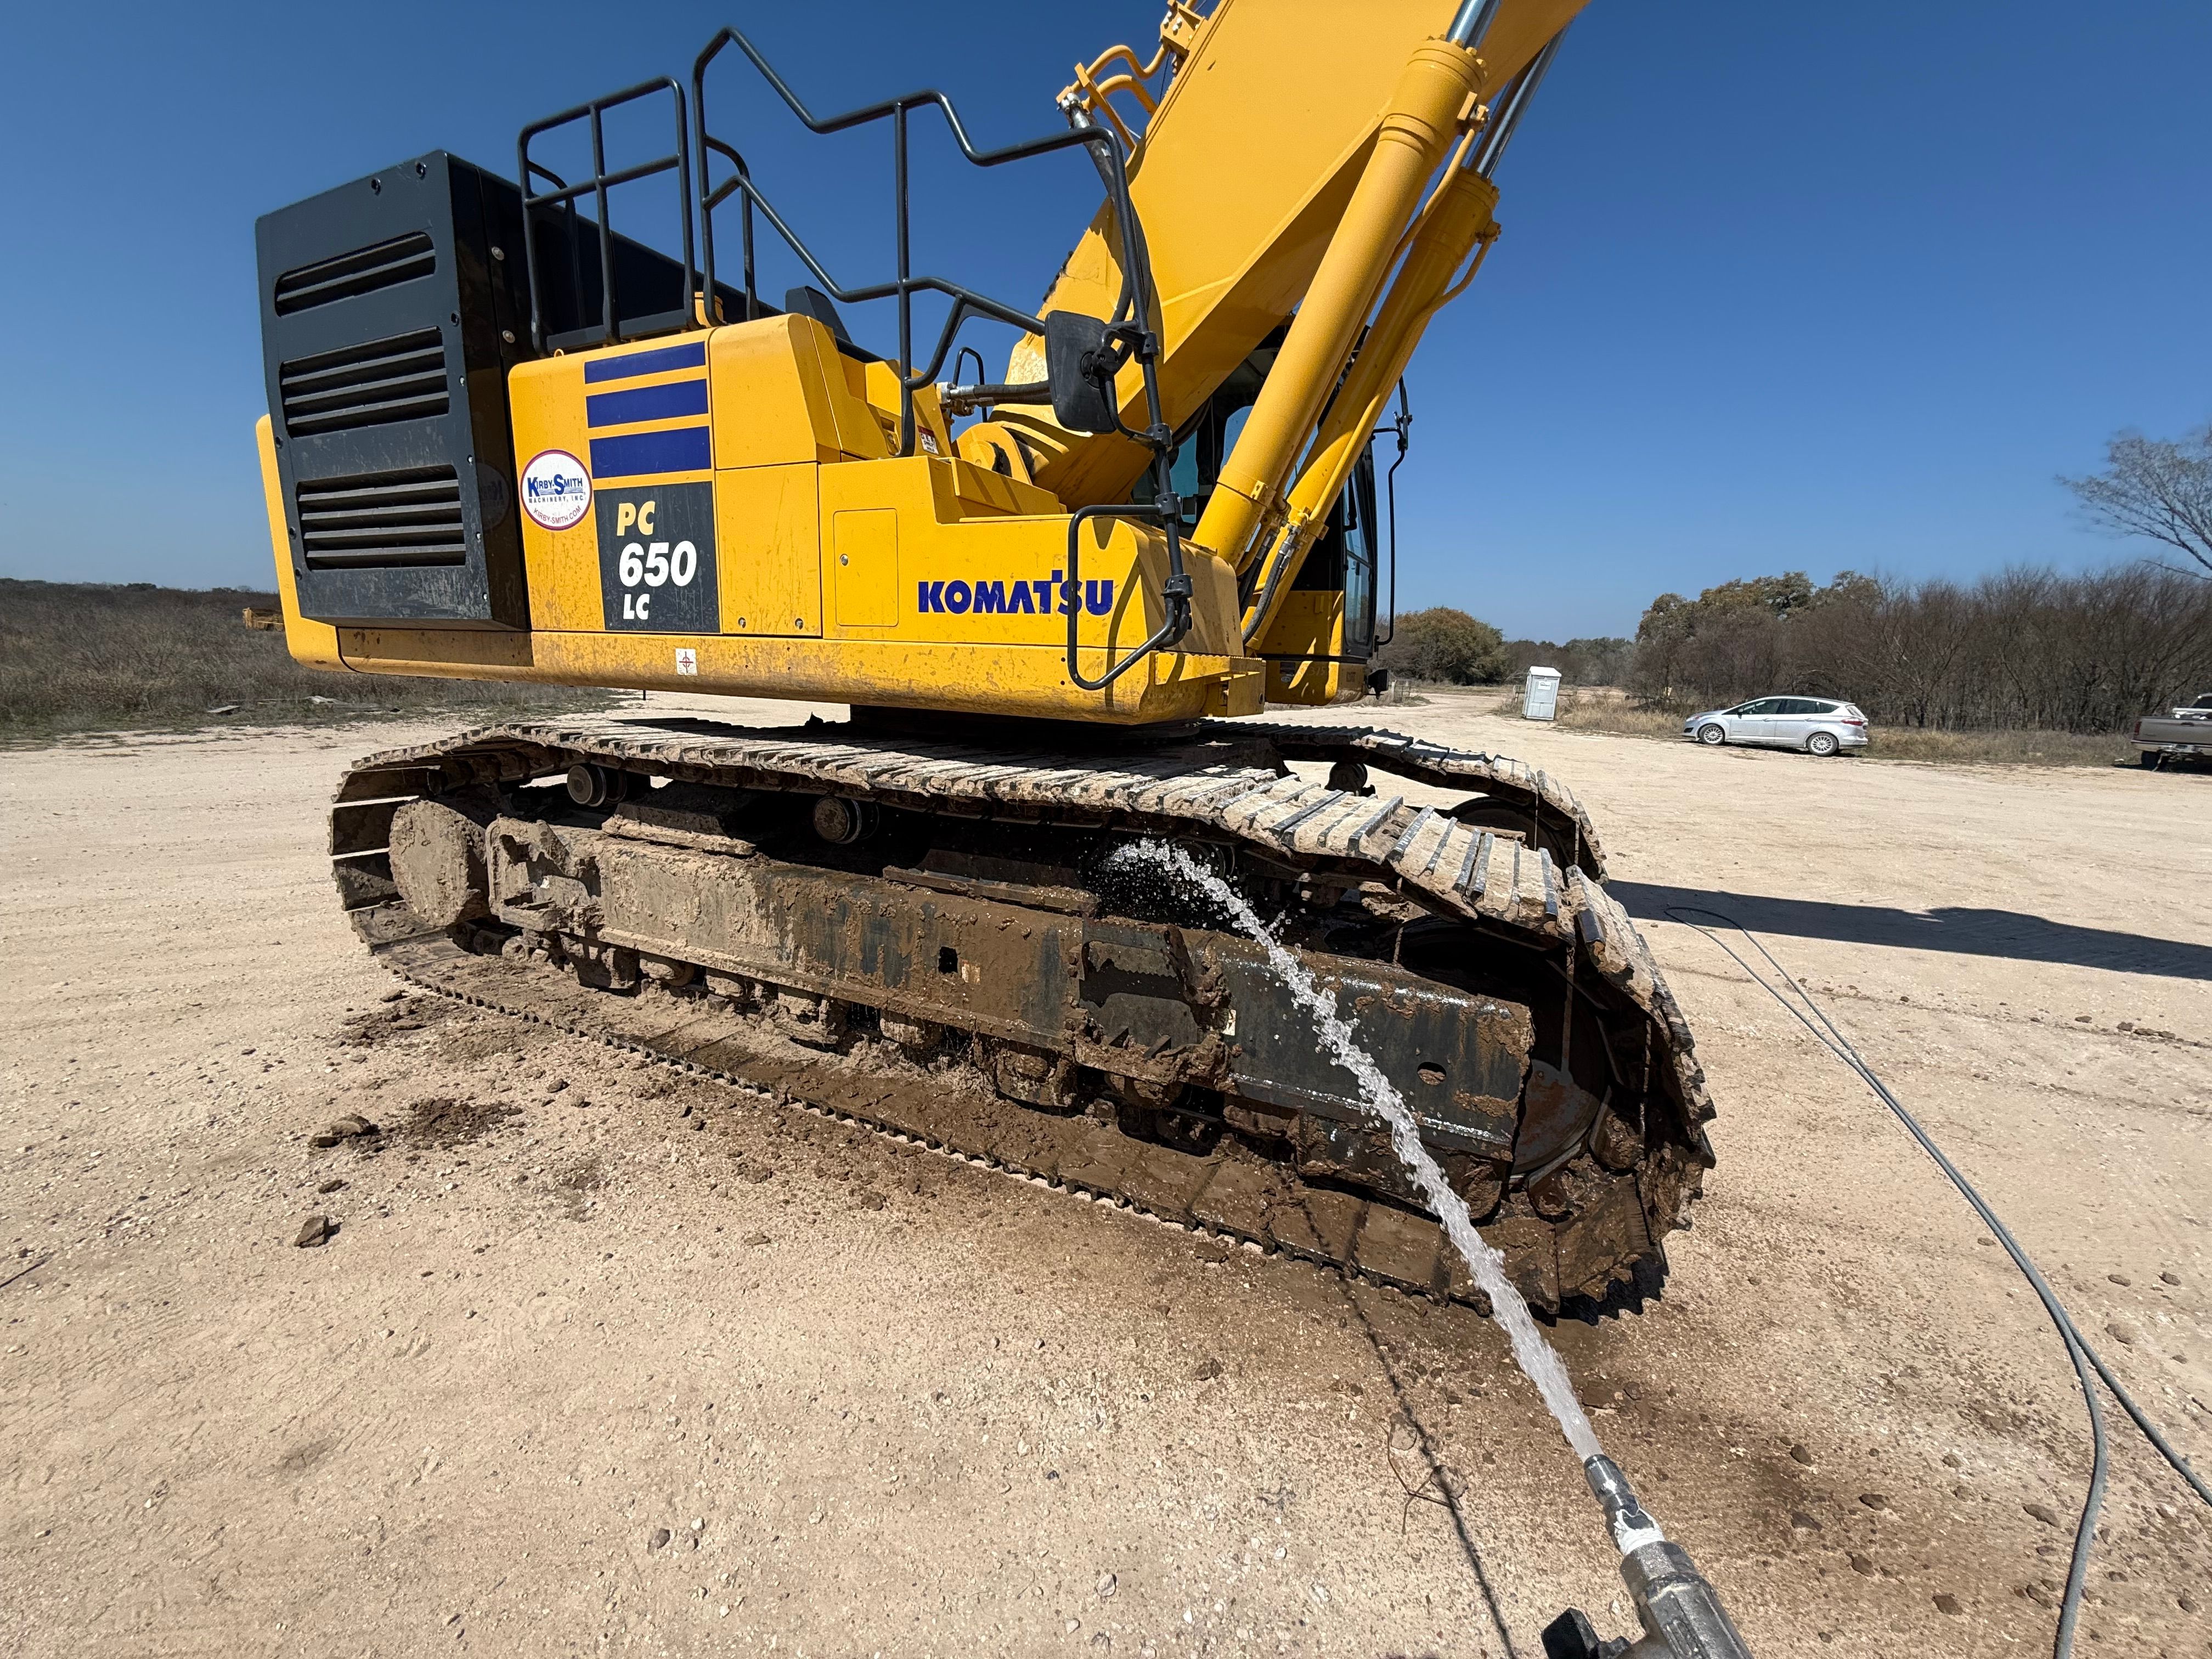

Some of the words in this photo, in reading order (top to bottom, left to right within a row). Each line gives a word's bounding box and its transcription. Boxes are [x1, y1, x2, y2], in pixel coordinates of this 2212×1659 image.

[533, 505, 582, 524] KIRBY-SMITH.COM
[617, 501, 656, 536] PC
[619, 540, 697, 587] 650
[623, 594, 650, 620] LC
[918, 569, 1114, 616] KOMATSU
